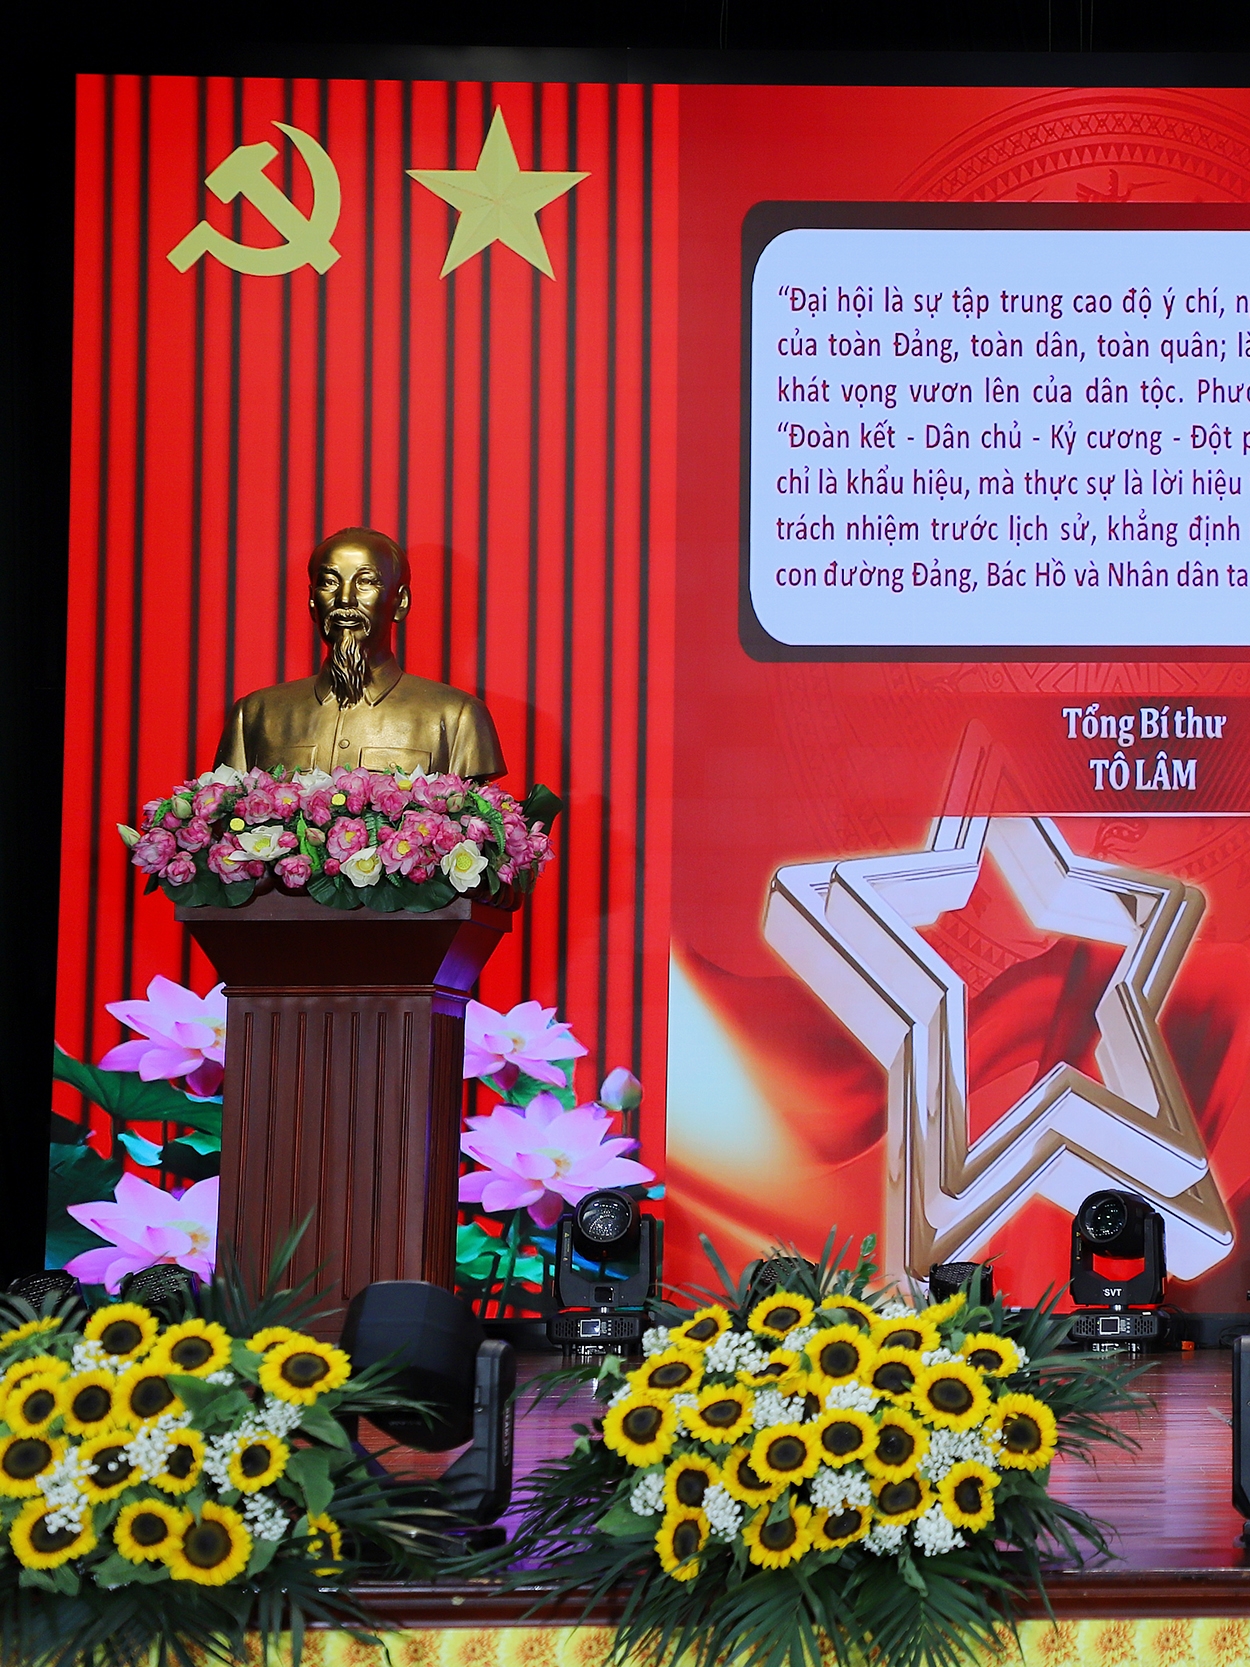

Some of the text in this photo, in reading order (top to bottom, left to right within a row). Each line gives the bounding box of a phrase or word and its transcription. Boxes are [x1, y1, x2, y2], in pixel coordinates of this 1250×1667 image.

[778, 284, 827, 318] “Đại
[837, 285, 874, 319] hội
[884, 285, 904, 313] là
[913, 291, 943, 319] sự
[951, 286, 990, 320] tập
[999, 289, 1064, 320] trung
[1072, 294, 1113, 314] cao
[1122, 286, 1152, 320] độ
[1162, 286, 1176, 320] ý
[1185, 286, 1225, 319] chí,
[777, 327, 817, 357] của
[827, 329, 881, 357] toàn
[892, 327, 959, 364] Đảng,
[970, 330, 1023, 358] toàn
[1035, 330, 1086, 363] dân,
[1096, 330, 1150, 358] toàn
[1160, 330, 1226, 365] quân;
[778, 375, 830, 403] khát
[840, 383, 898, 410] vọng
[909, 382, 973, 403] vươn
[985, 376, 1020, 403] lên
[1032, 374, 1072, 404] của
[1085, 376, 1128, 404] dân
[1139, 376, 1184, 410] tộc.
[777, 421, 850, 449] “Đoàn
[860, 418, 896, 449] kết
[925, 422, 970, 449] Dân
[981, 419, 1022, 449] chủ
[1051, 420, 1077, 456] Kỷ
[1086, 428, 1163, 456] cương
[1190, 422, 1233, 456] Đột
[776, 465, 810, 495] chỉ
[818, 467, 838, 495] là
[847, 463, 904, 495] khẩu
[913, 468, 970, 501] hiệu,
[979, 468, 1014, 495] mà
[1023, 468, 1079, 502] thực
[1086, 474, 1116, 502] sự
[1124, 468, 1143, 496] là
[1152, 468, 1183, 496] lời
[1192, 468, 1242, 502] hiệu
[775, 513, 835, 541] trách
[846, 513, 919, 547] nhiệm
[930, 513, 999, 541] trước
[1009, 514, 1048, 547] lịch
[1060, 511, 1097, 547] sử,
[1108, 508, 1179, 548] khẳng
[1188, 514, 1240, 548] định
[775, 567, 817, 587] con
[823, 559, 905, 594] đường
[911, 557, 978, 594] Đảng,
[987, 559, 1027, 587] Bác
[1035, 557, 1066, 587] Hồ
[1073, 560, 1100, 588] và
[1108, 560, 1169, 588] Nhân
[1176, 560, 1219, 587] dân
[1226, 564, 1249, 588] ta
[1062, 702, 1227, 747] Tổng Bí thư
[1090, 751, 1197, 791] TÔ LÂM
[1103, 1288, 1122, 1297] SVT
